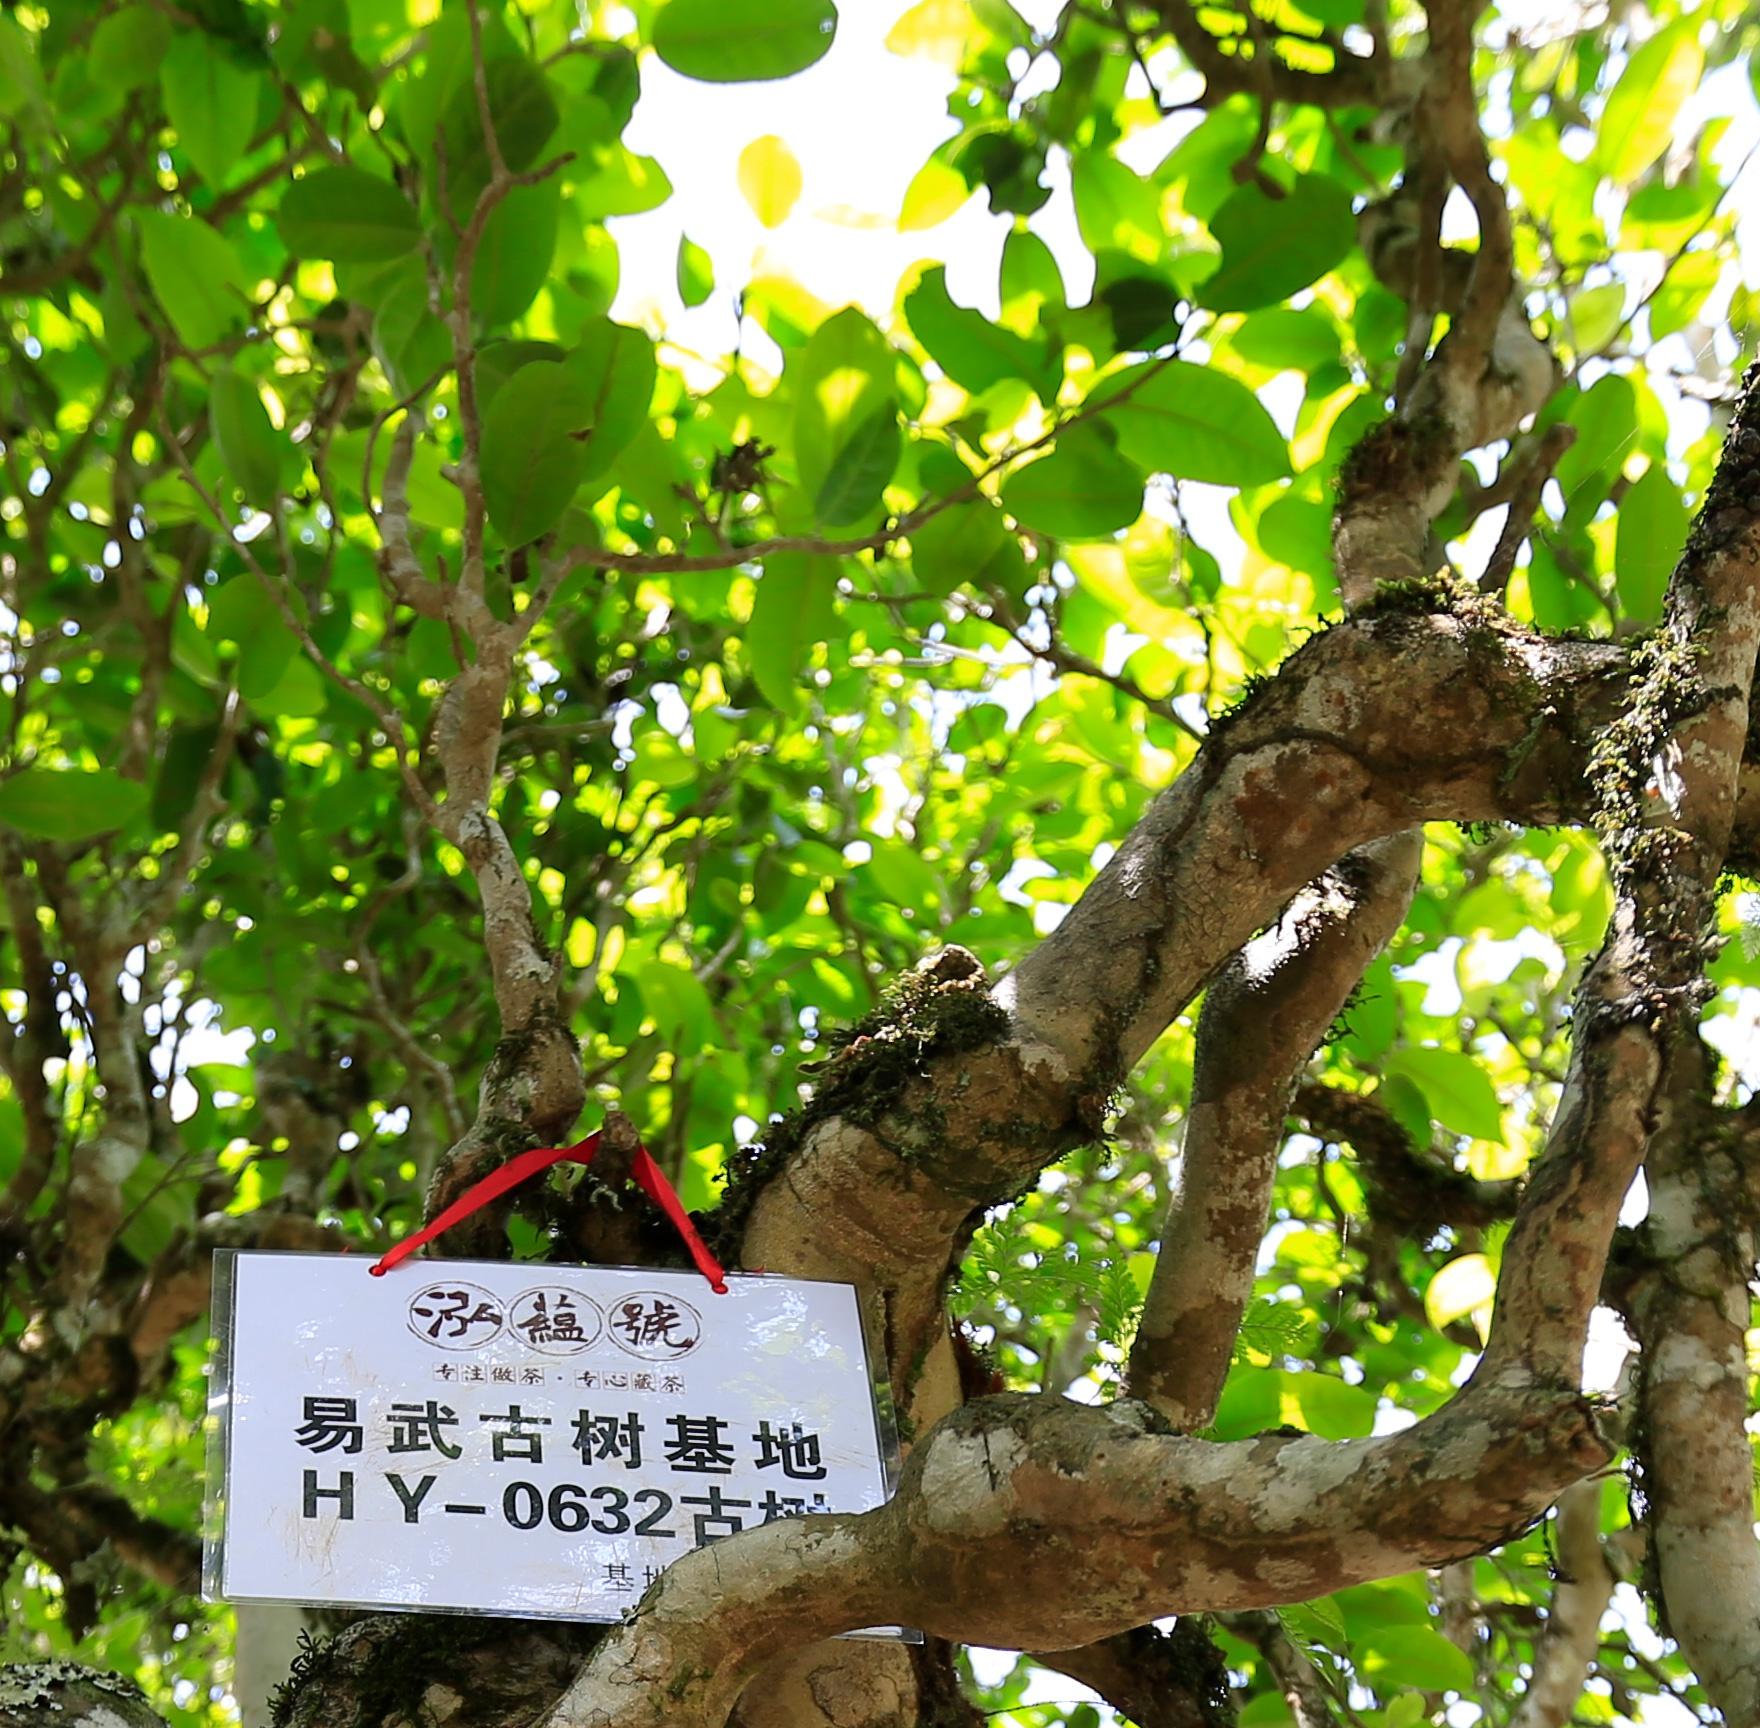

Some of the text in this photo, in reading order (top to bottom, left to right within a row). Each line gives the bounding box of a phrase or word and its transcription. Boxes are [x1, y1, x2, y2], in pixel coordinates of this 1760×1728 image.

[294, 1396, 828, 1481] 易武古树基地
